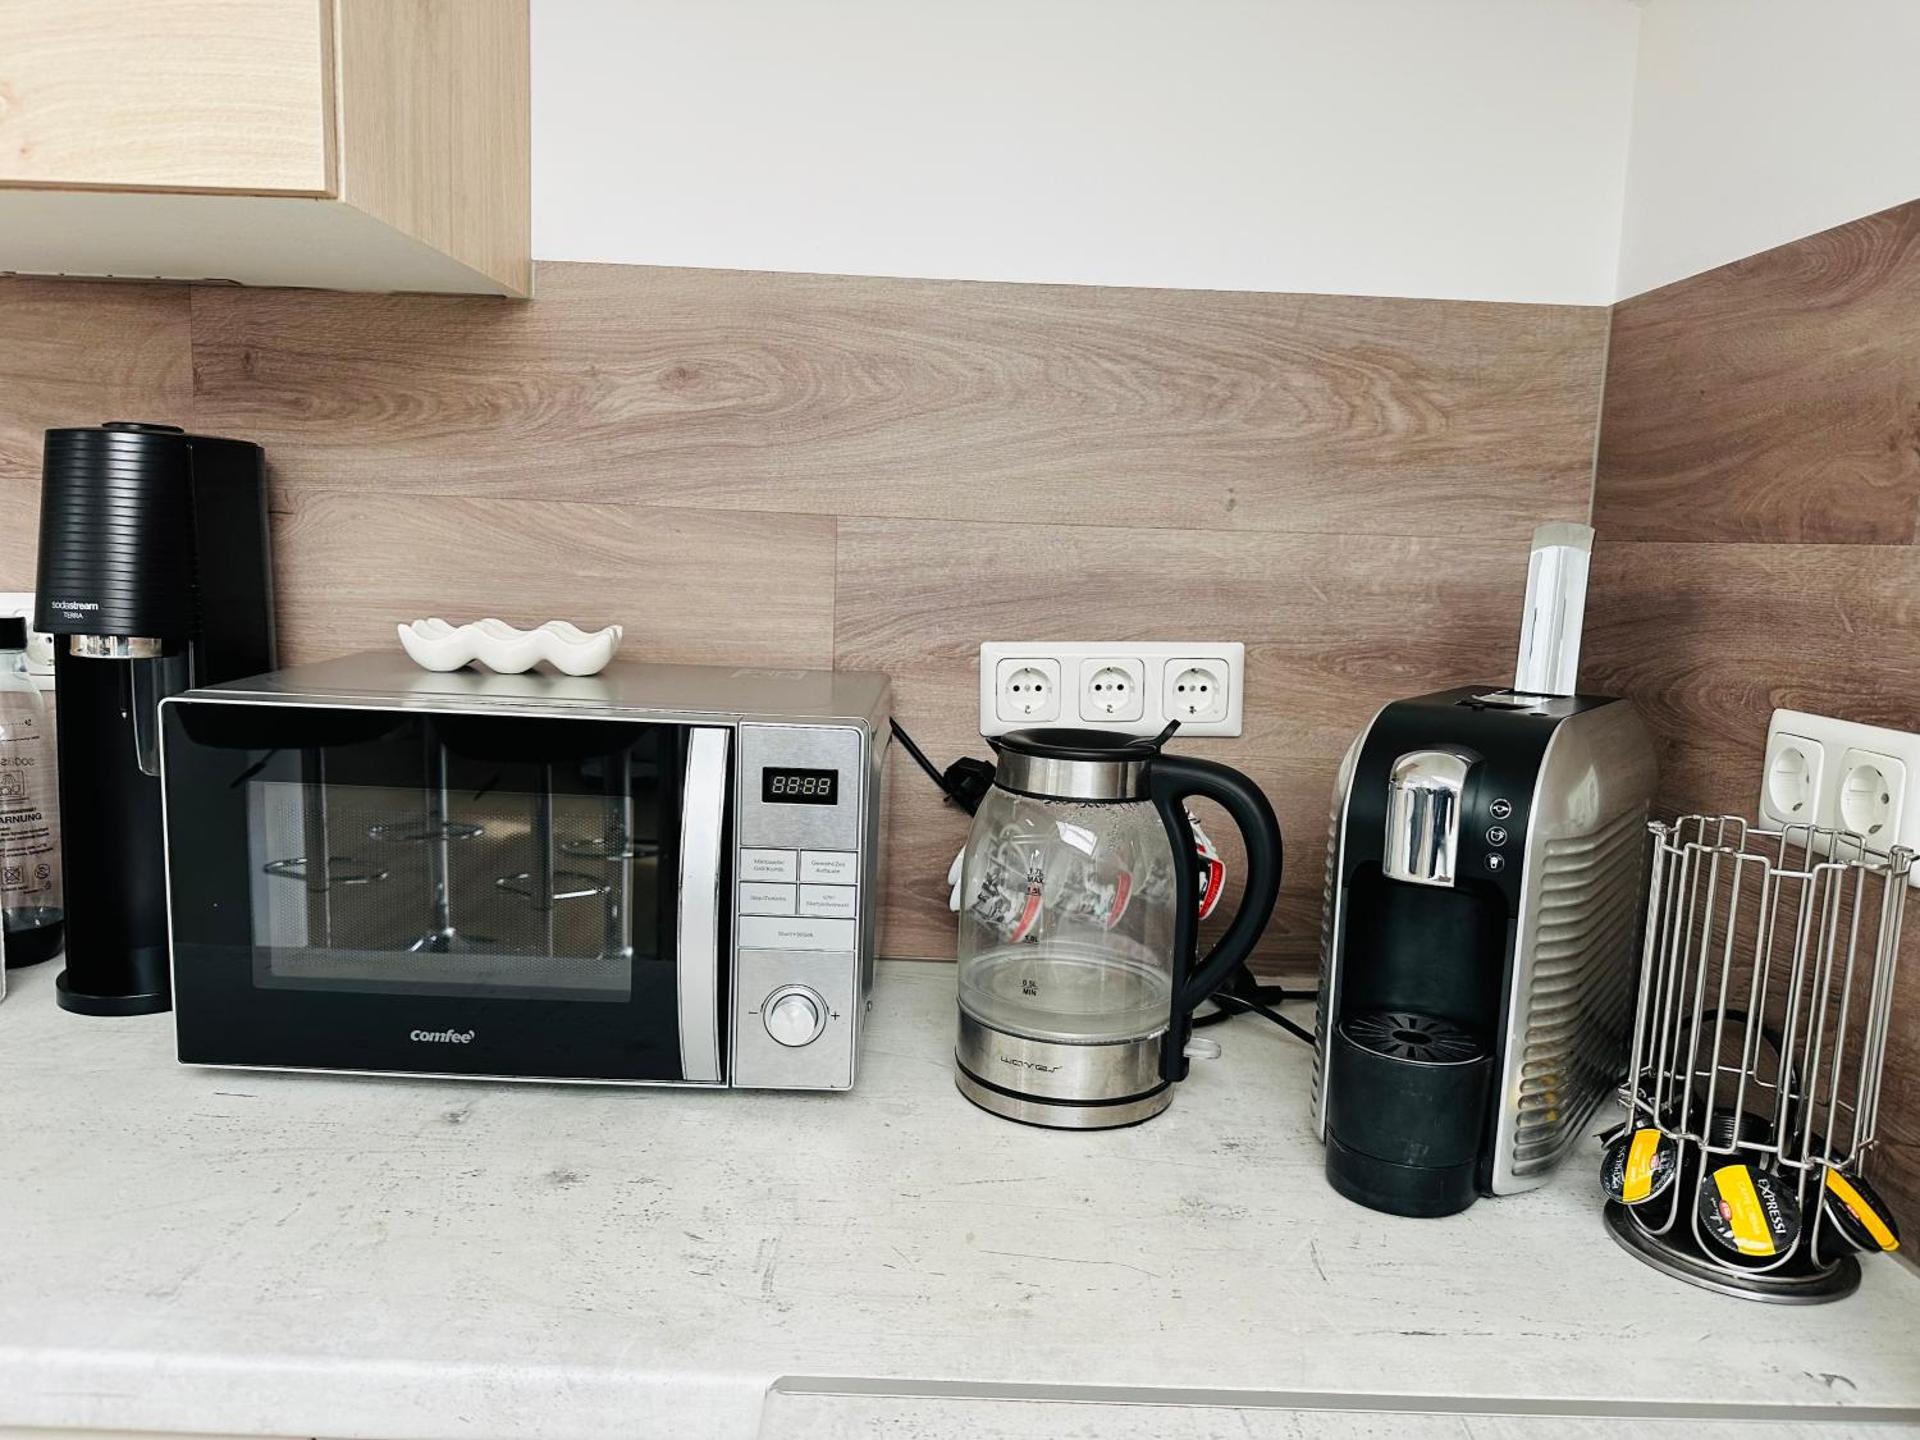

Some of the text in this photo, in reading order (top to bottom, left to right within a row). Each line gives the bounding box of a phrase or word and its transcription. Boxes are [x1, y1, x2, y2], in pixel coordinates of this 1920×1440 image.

[51, 600, 99, 611] sodastream
[63, 611, 83, 619] TERRA
[1027, 876, 1044, 885] MAX
[1022, 987, 1037, 997] MIN
[1757, 1178, 1788, 1234] EXPRESSI
